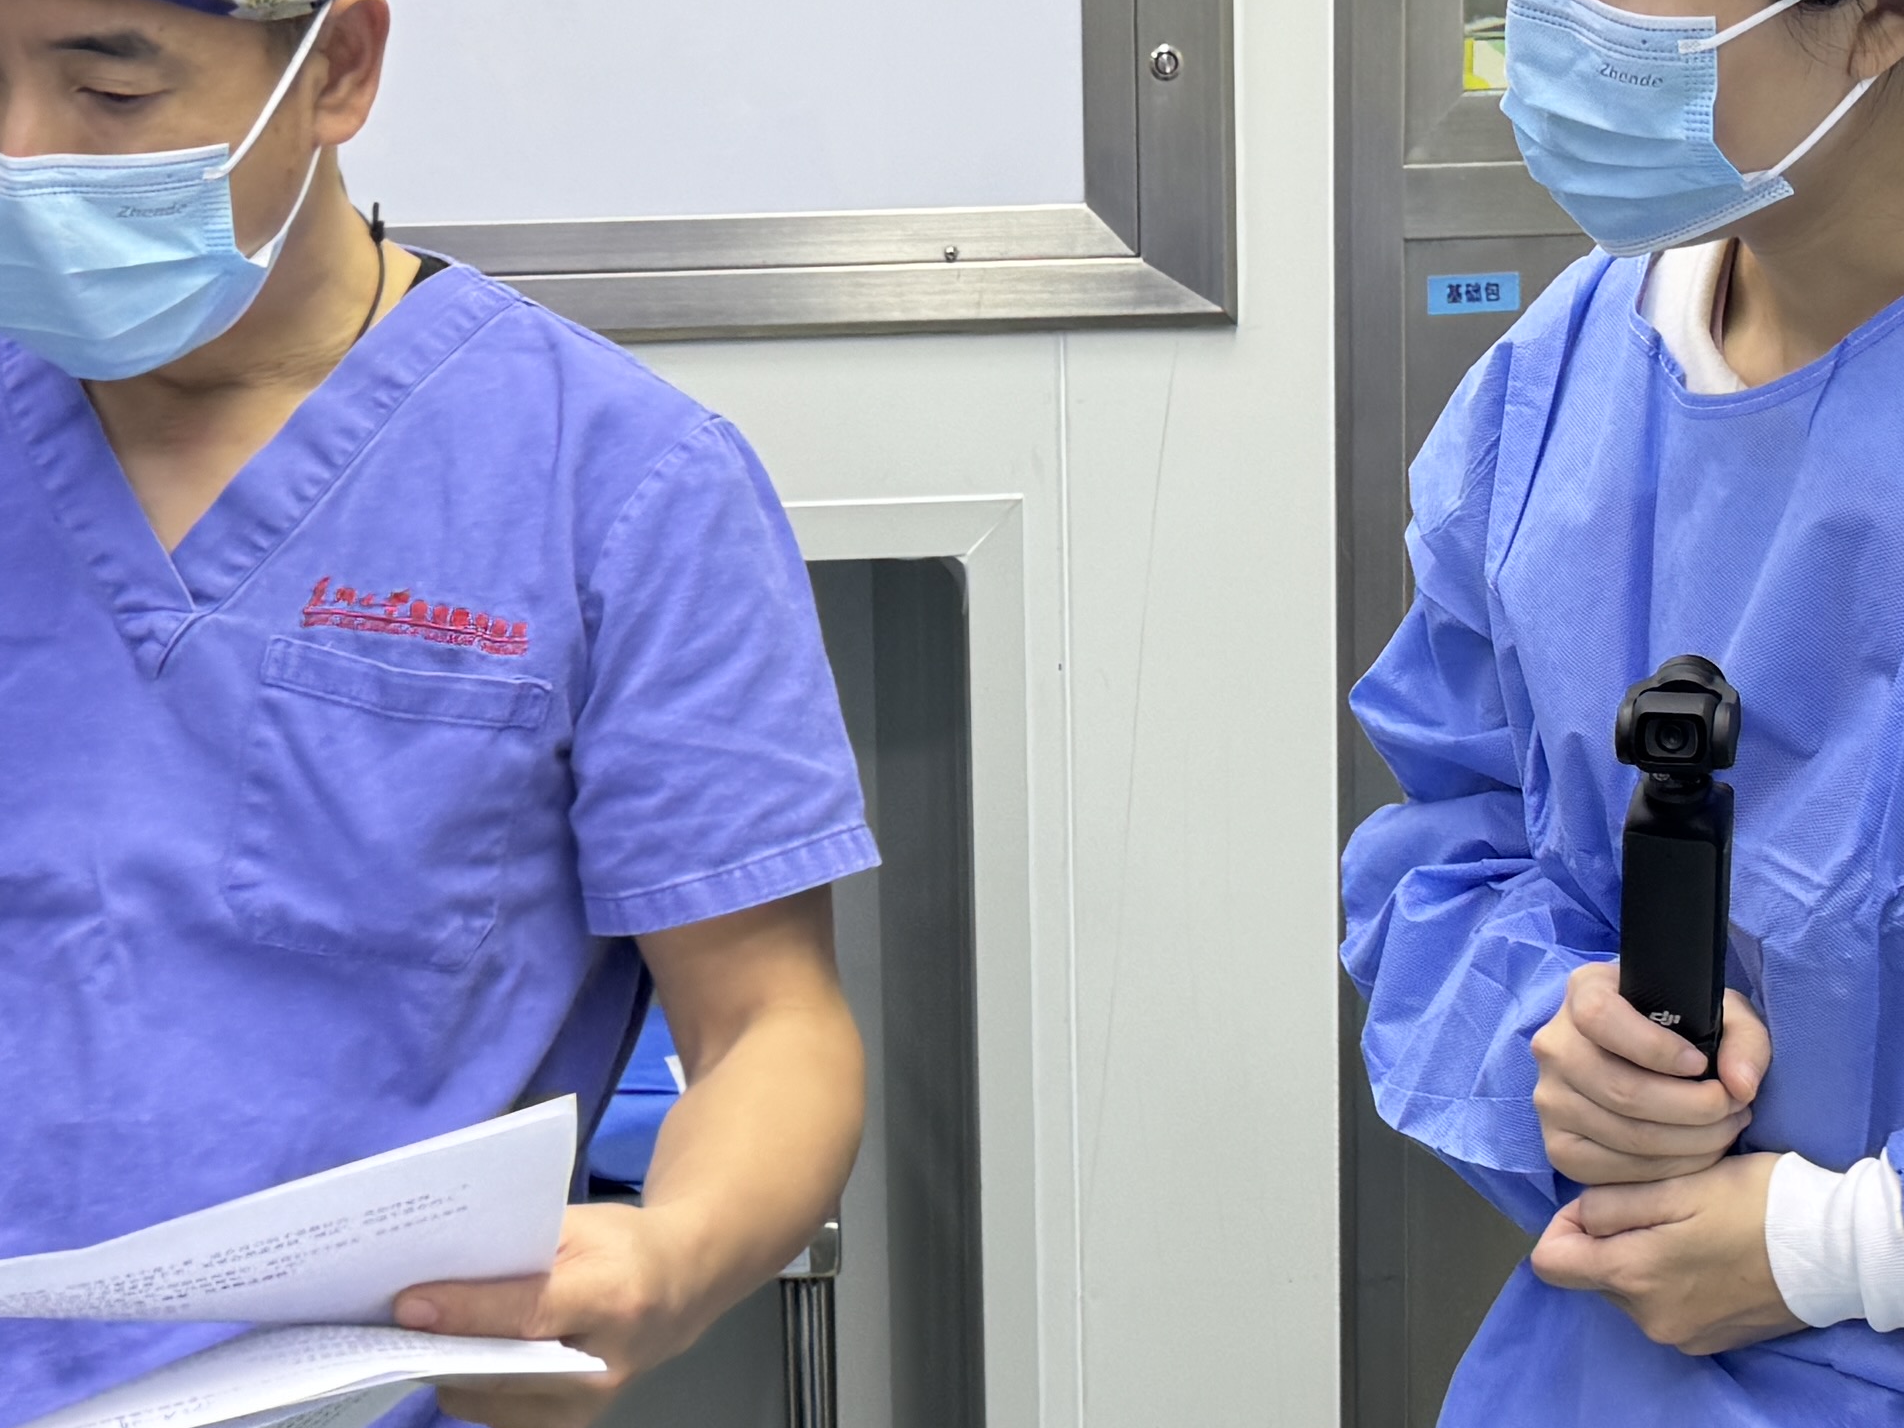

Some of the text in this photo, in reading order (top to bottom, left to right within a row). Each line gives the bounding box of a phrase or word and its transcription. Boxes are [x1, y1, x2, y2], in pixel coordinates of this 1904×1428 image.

[1596, 60, 1664, 90] Zhende
[115, 201, 189, 219] Zhende
[1446, 281, 1501, 304] 基础包
